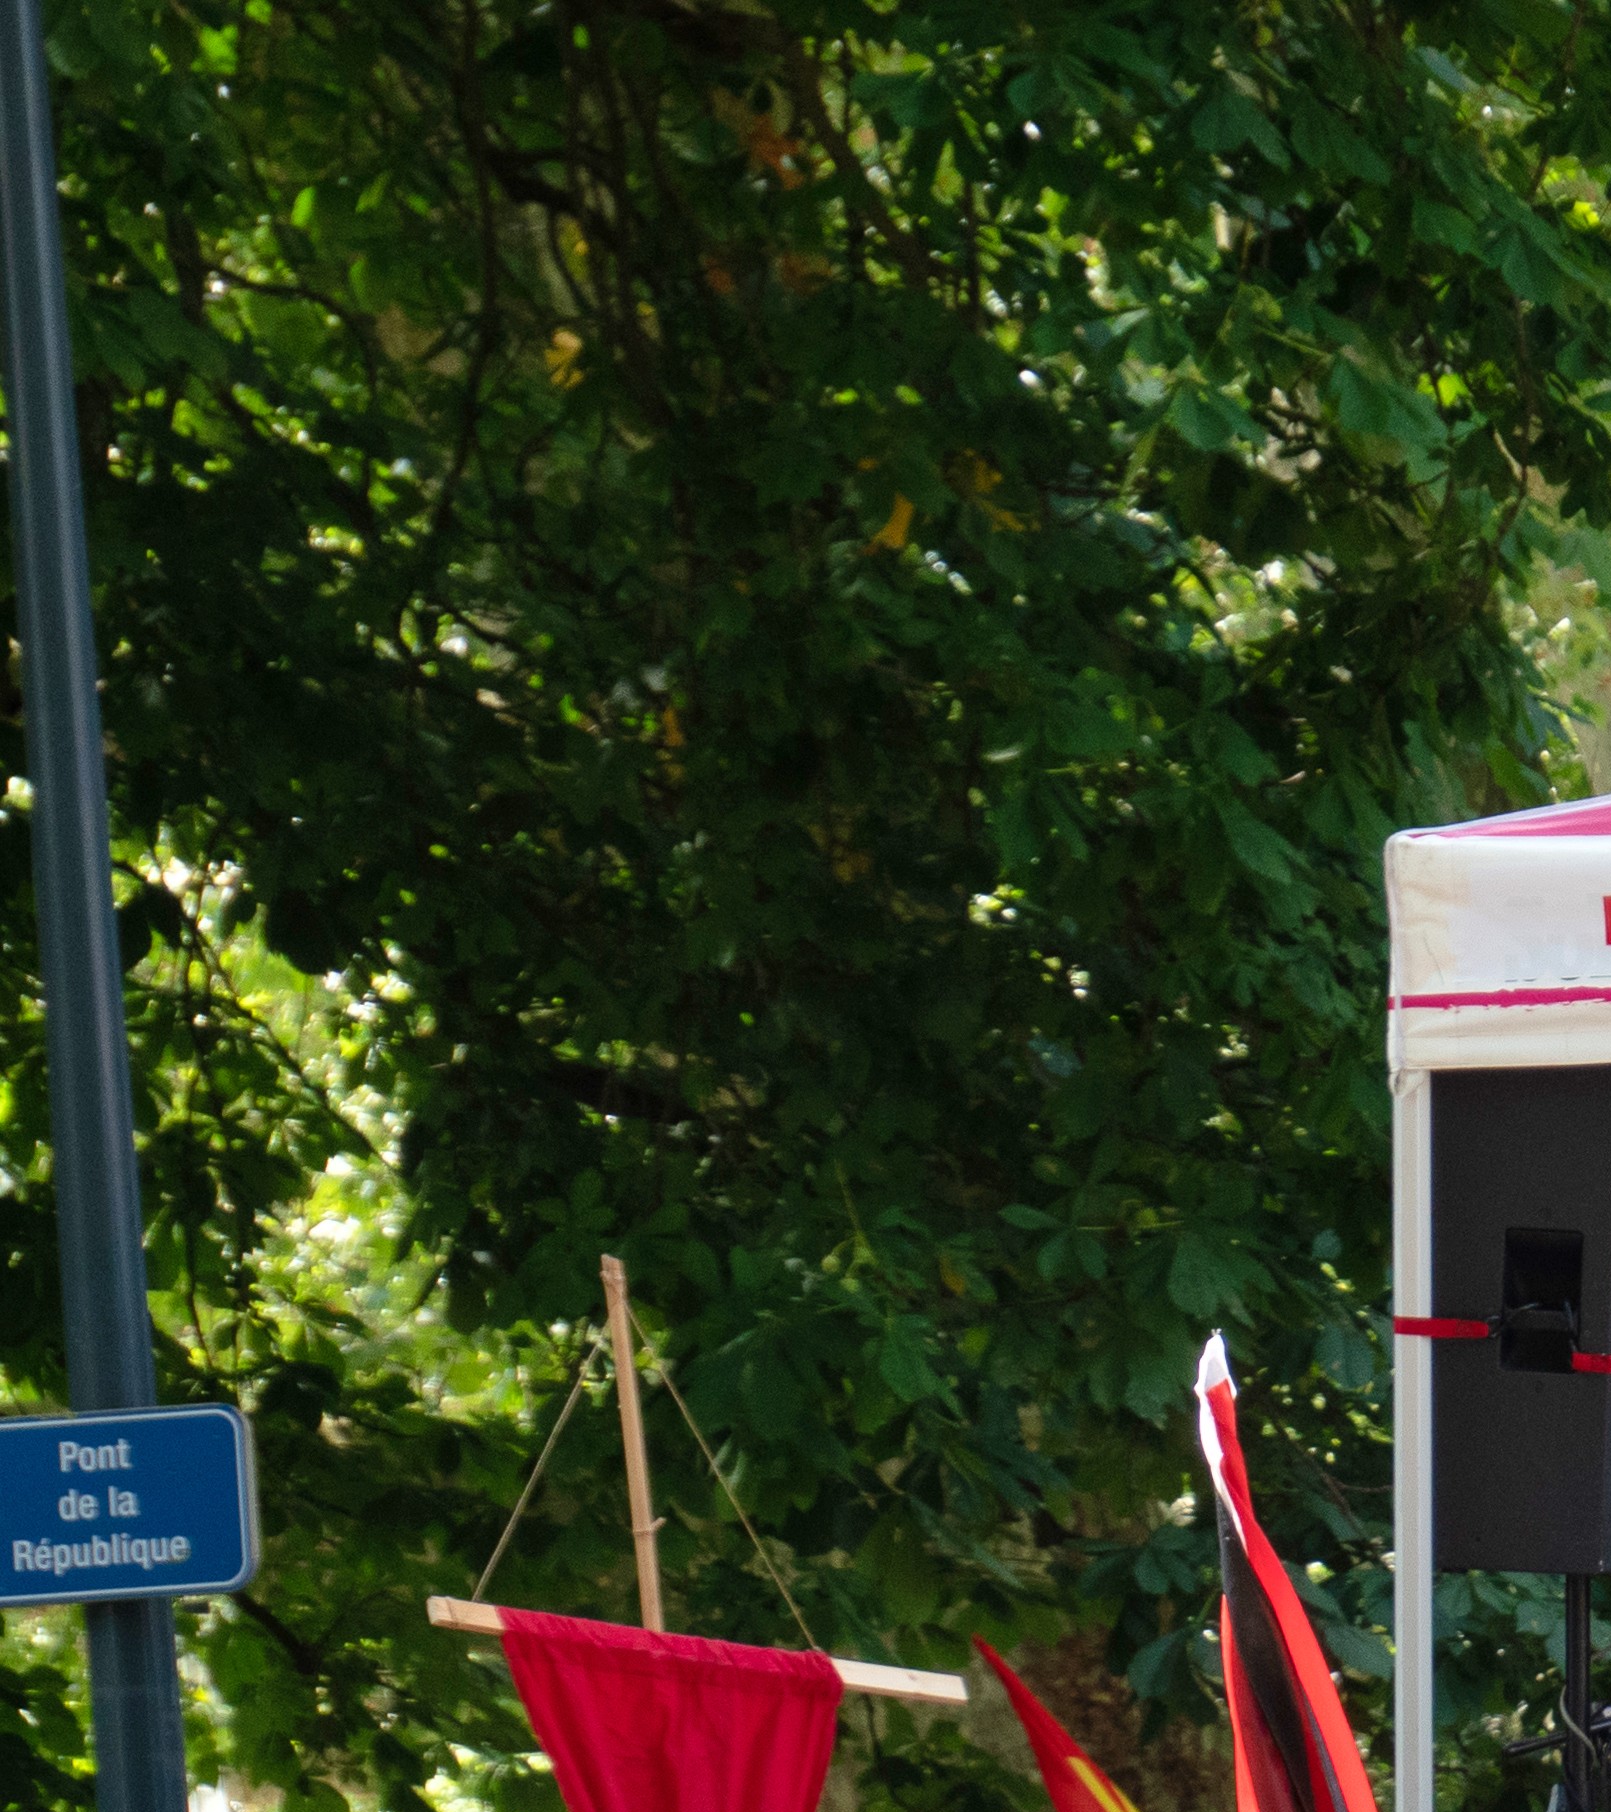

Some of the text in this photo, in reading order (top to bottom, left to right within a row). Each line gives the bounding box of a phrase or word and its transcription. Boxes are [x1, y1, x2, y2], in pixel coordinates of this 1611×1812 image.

[58, 1437, 133, 1473] Pont
[58, 1486, 139, 1521] de la
[12, 1533, 192, 1577] République
